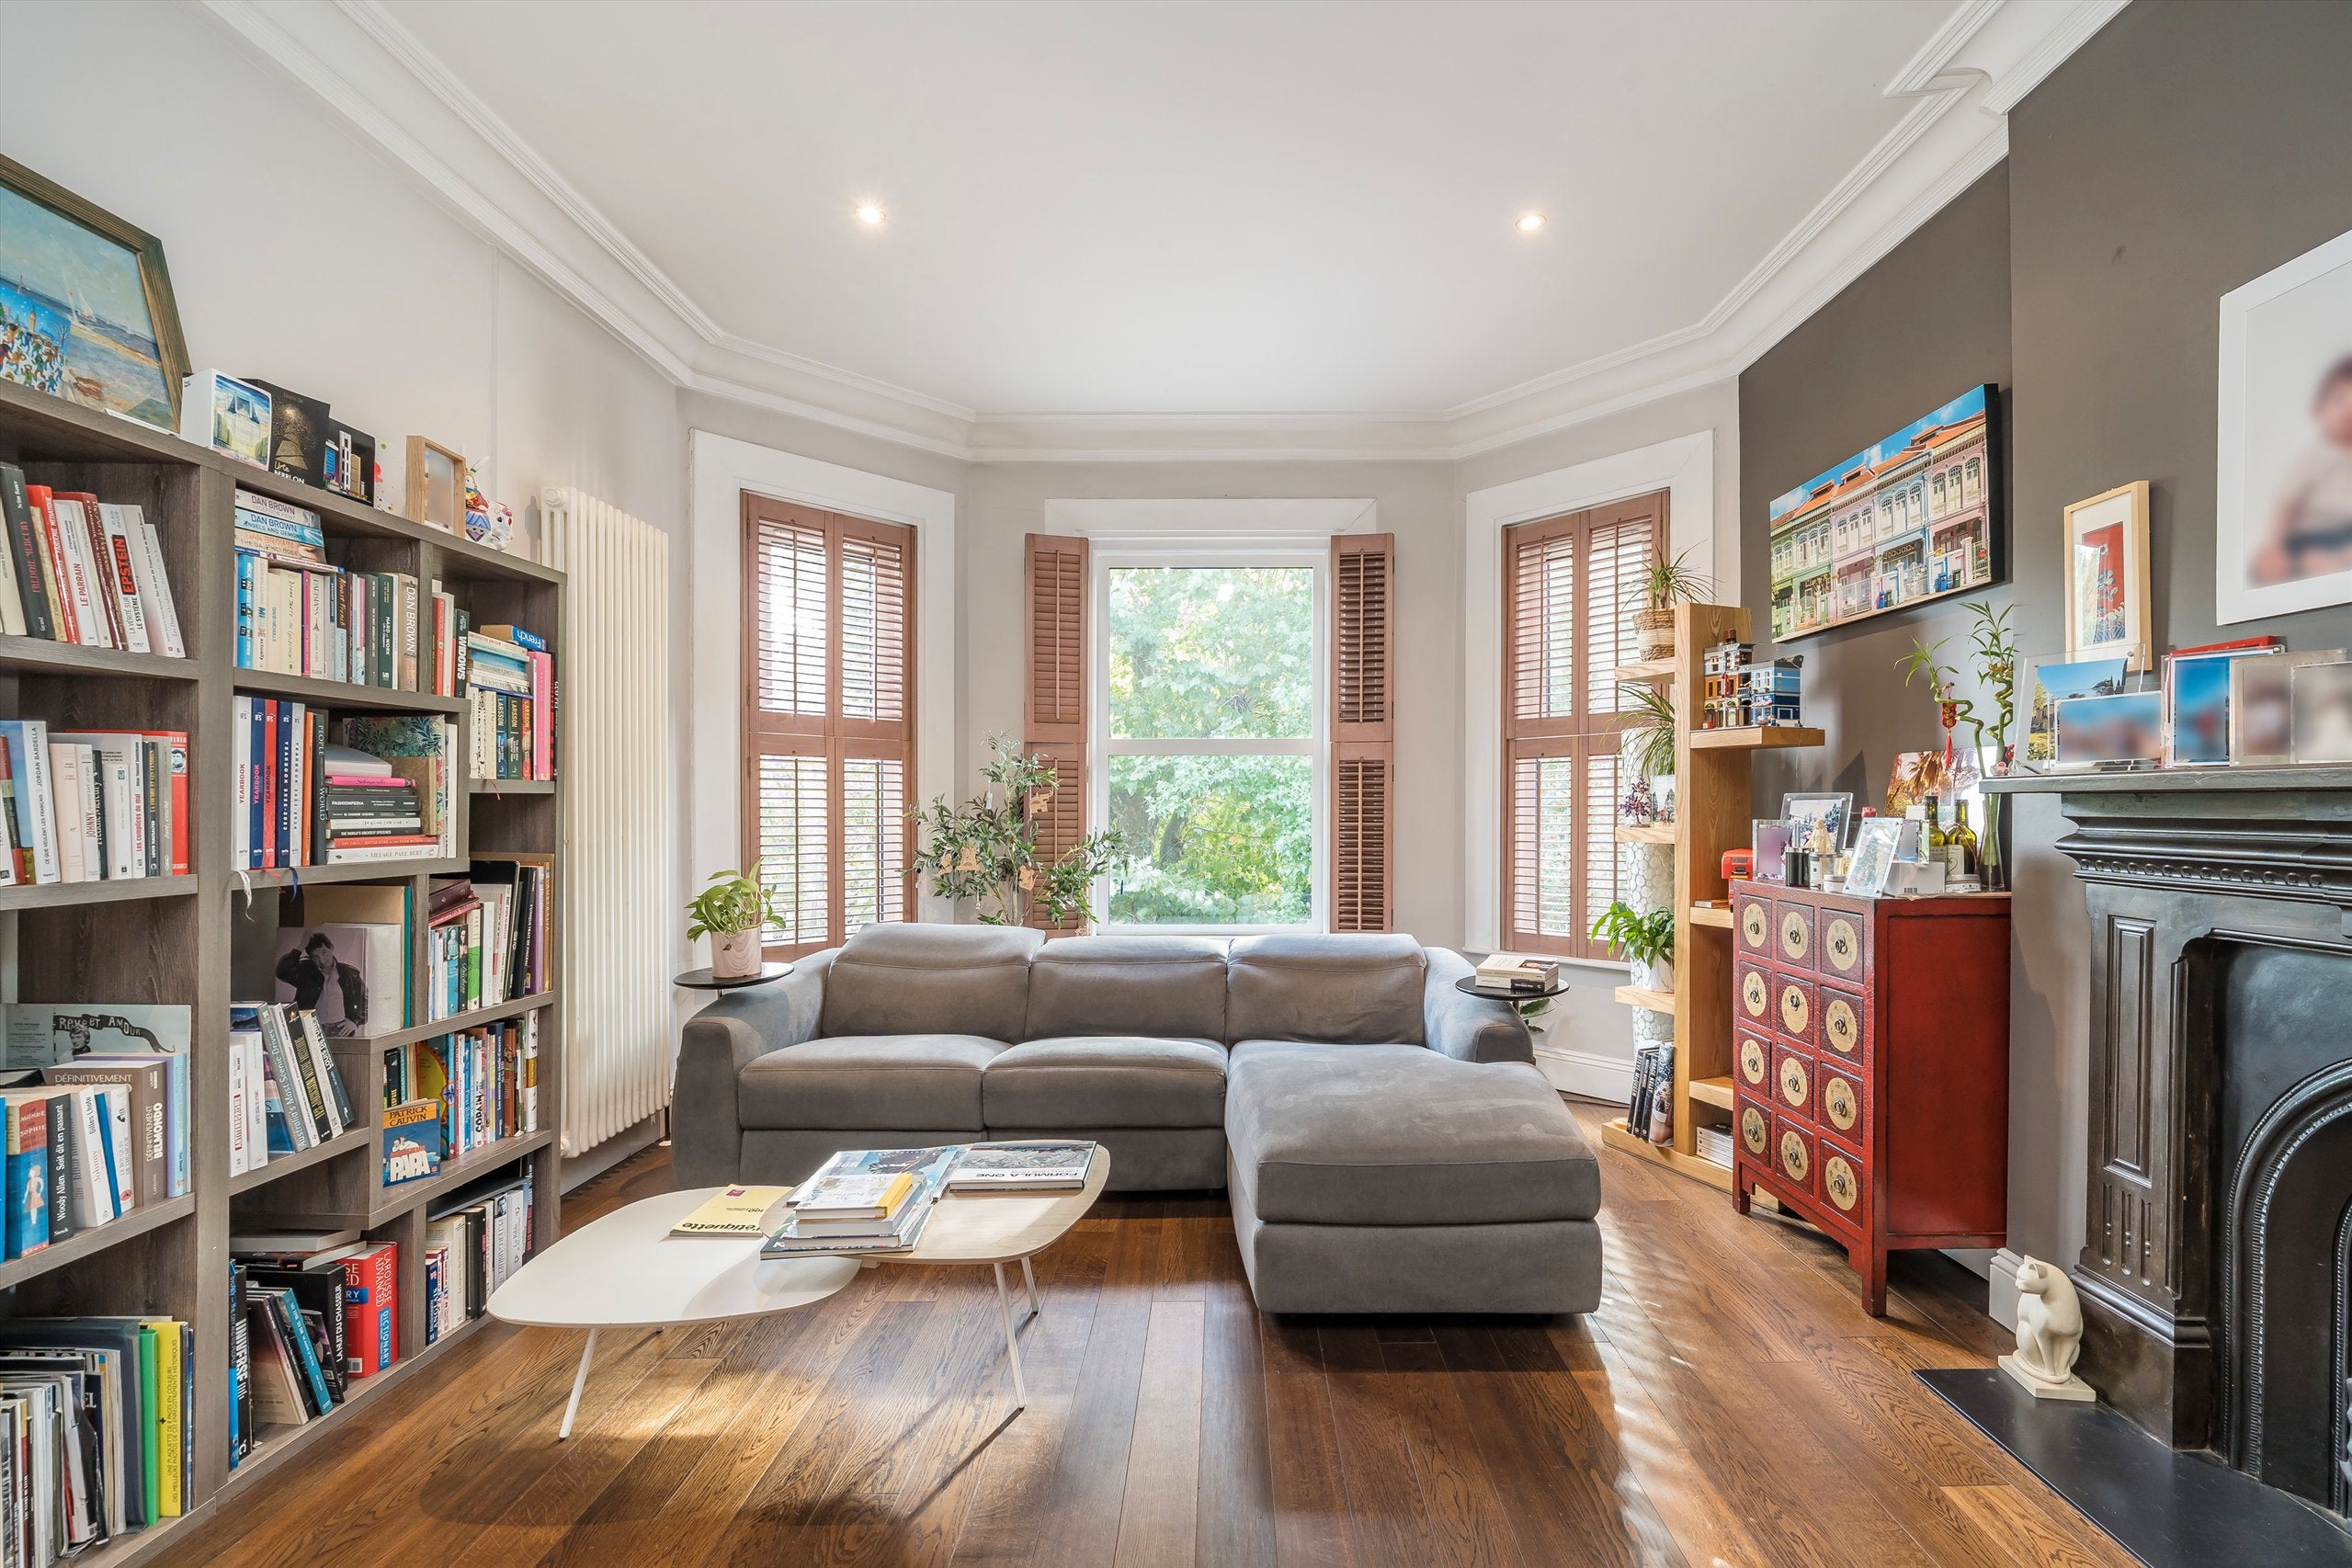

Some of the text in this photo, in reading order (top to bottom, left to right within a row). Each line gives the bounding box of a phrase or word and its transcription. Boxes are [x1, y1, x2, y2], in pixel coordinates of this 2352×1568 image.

[251, 495, 295, 515] DAN BROWN
[243, 520, 266, 531] ANGELS
[280, 530, 304, 540] DEMONS
[251, 515, 297, 532] DAN BROWN
[265, 536, 293, 549] BROWN
[114, 539, 134, 593] EPSTEIN
[74, 563, 88, 607] LE PARRAIN
[125, 610, 134, 626] VÉRITÉ
[131, 597, 142, 622] SYSTÈME
[405, 586, 415, 653] DAN BROWN
[517, 629, 543, 649] French
[457, 636, 467, 680] WIDOWS
[31, 727, 43, 787] JORDAN BARDELLA
[108, 1017, 141, 1035] AMOUR
[318, 1040, 326, 1049] DE
[321, 1050, 334, 1070] LOUIS
[55, 1073, 132, 1083] DÉFINITIVEMENT
[268, 1028, 307, 1147] Australia's Most Scenic Drives
[20, 1110, 46, 1121] MONDE
[389, 1105, 427, 1119] PATRICK
[390, 1113, 426, 1128] CAUVIN
[20, 1124, 47, 1135] SOPHIE
[88, 1115, 97, 1135] Gilles
[145, 1106, 153, 1162] DÉFINITIVEMENT
[153, 1102, 164, 1159] BELMONDO
[56, 1105, 66, 1221] Woody Soit dit en passant
[390, 1150, 431, 1183] PAPA
[495, 1217, 506, 1275] PETER GABRIEL
[375, 1257, 384, 1307] ADVANCED
[383, 1252, 392, 1303] LAROUSSE
[335, 1322, 343, 1333] DU
[235, 1318, 246, 1381] UNIVERSE
[336, 1350, 343, 1362] LA
[167, 1395, 172, 1403] EN
